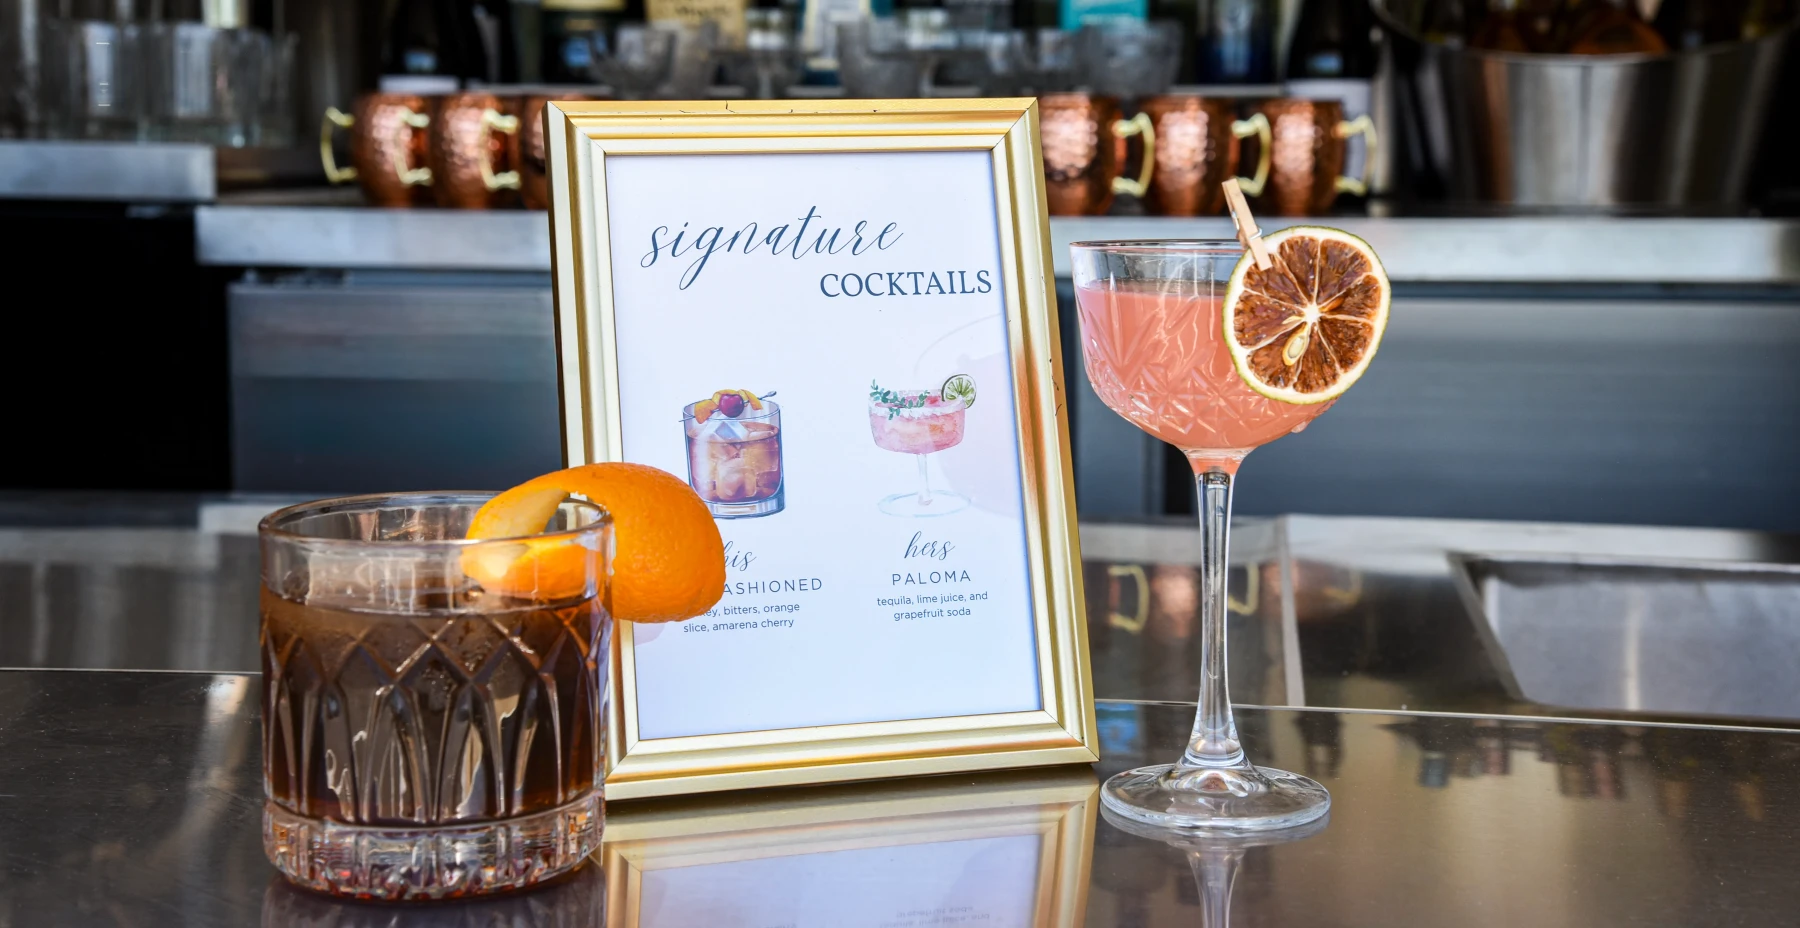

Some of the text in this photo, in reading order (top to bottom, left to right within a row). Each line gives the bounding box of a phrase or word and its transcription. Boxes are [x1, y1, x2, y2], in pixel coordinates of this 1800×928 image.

[640, 206, 904, 291] signature
[820, 269, 992, 297] COCKTAILS
[904, 530, 956, 561] hers
[891, 570, 971, 585] PALOMA
[724, 578, 823, 596] ASHIONED
[876, 591, 988, 607] tequila, lime juice, and
[723, 605, 761, 616] bitters,
[763, 602, 800, 614] orange
[893, 607, 971, 622] grapefruit soda
[683, 617, 795, 633] slice, amarena cherry
